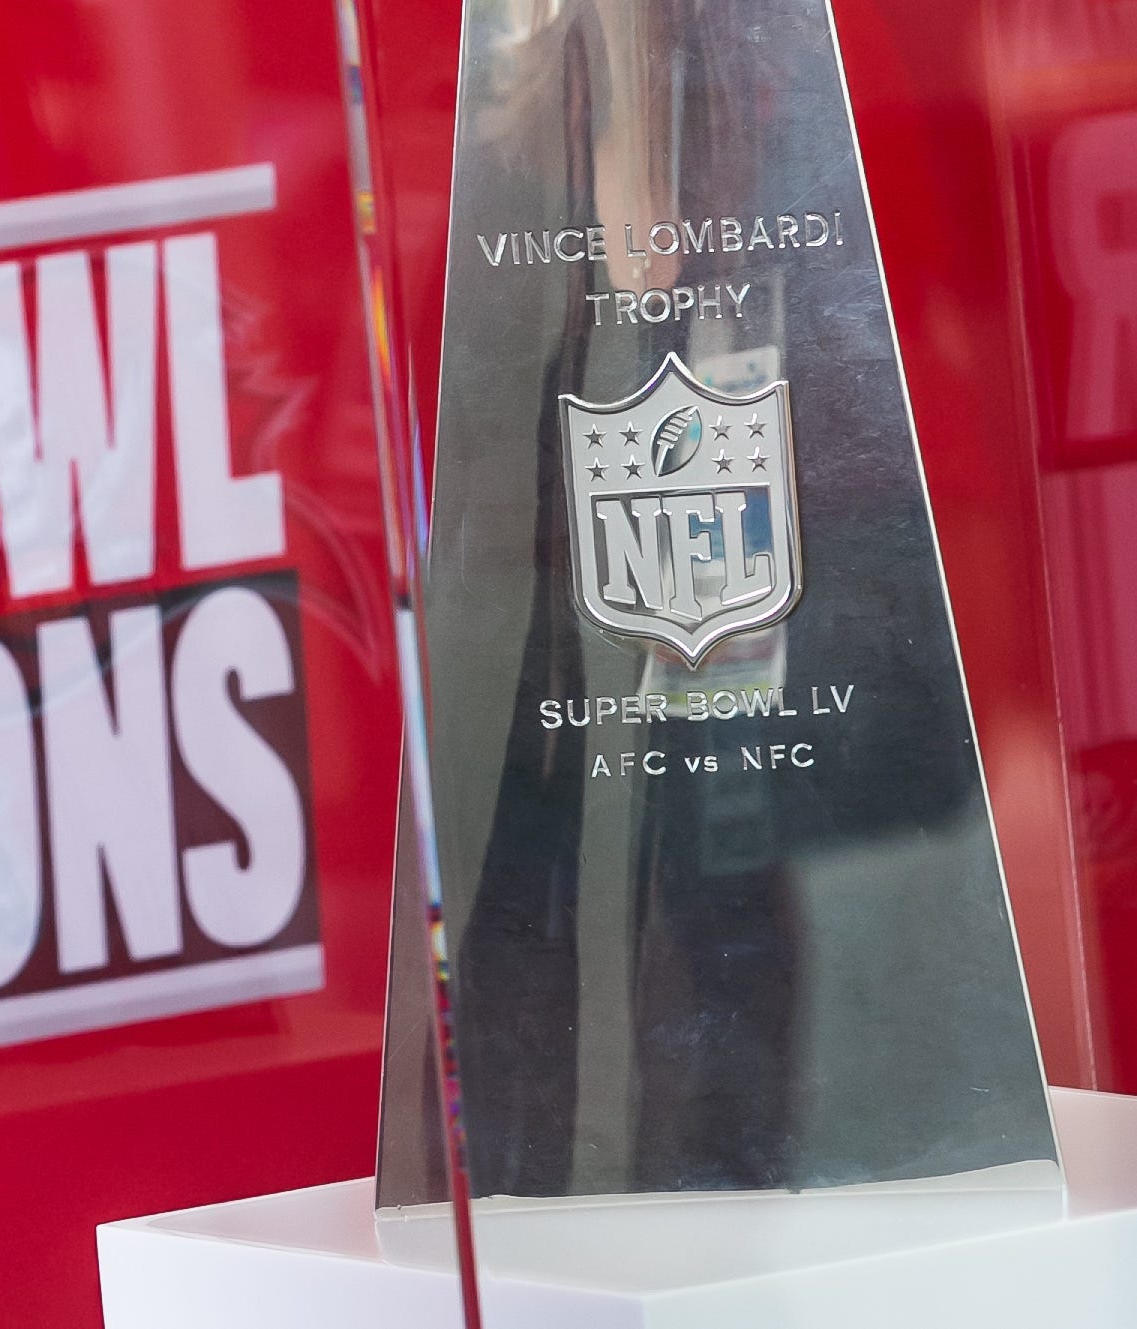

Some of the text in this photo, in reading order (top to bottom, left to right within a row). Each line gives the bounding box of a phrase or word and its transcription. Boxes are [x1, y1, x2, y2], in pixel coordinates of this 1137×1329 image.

[476, 210, 845, 268] VINCE LOMBARDI
[585, 283, 751, 327] TROPHY
[595, 491, 774, 622] NFL
[539, 684, 855, 730] SUPER BOWL LV
[591, 742, 815, 778] AFC vs NFC
